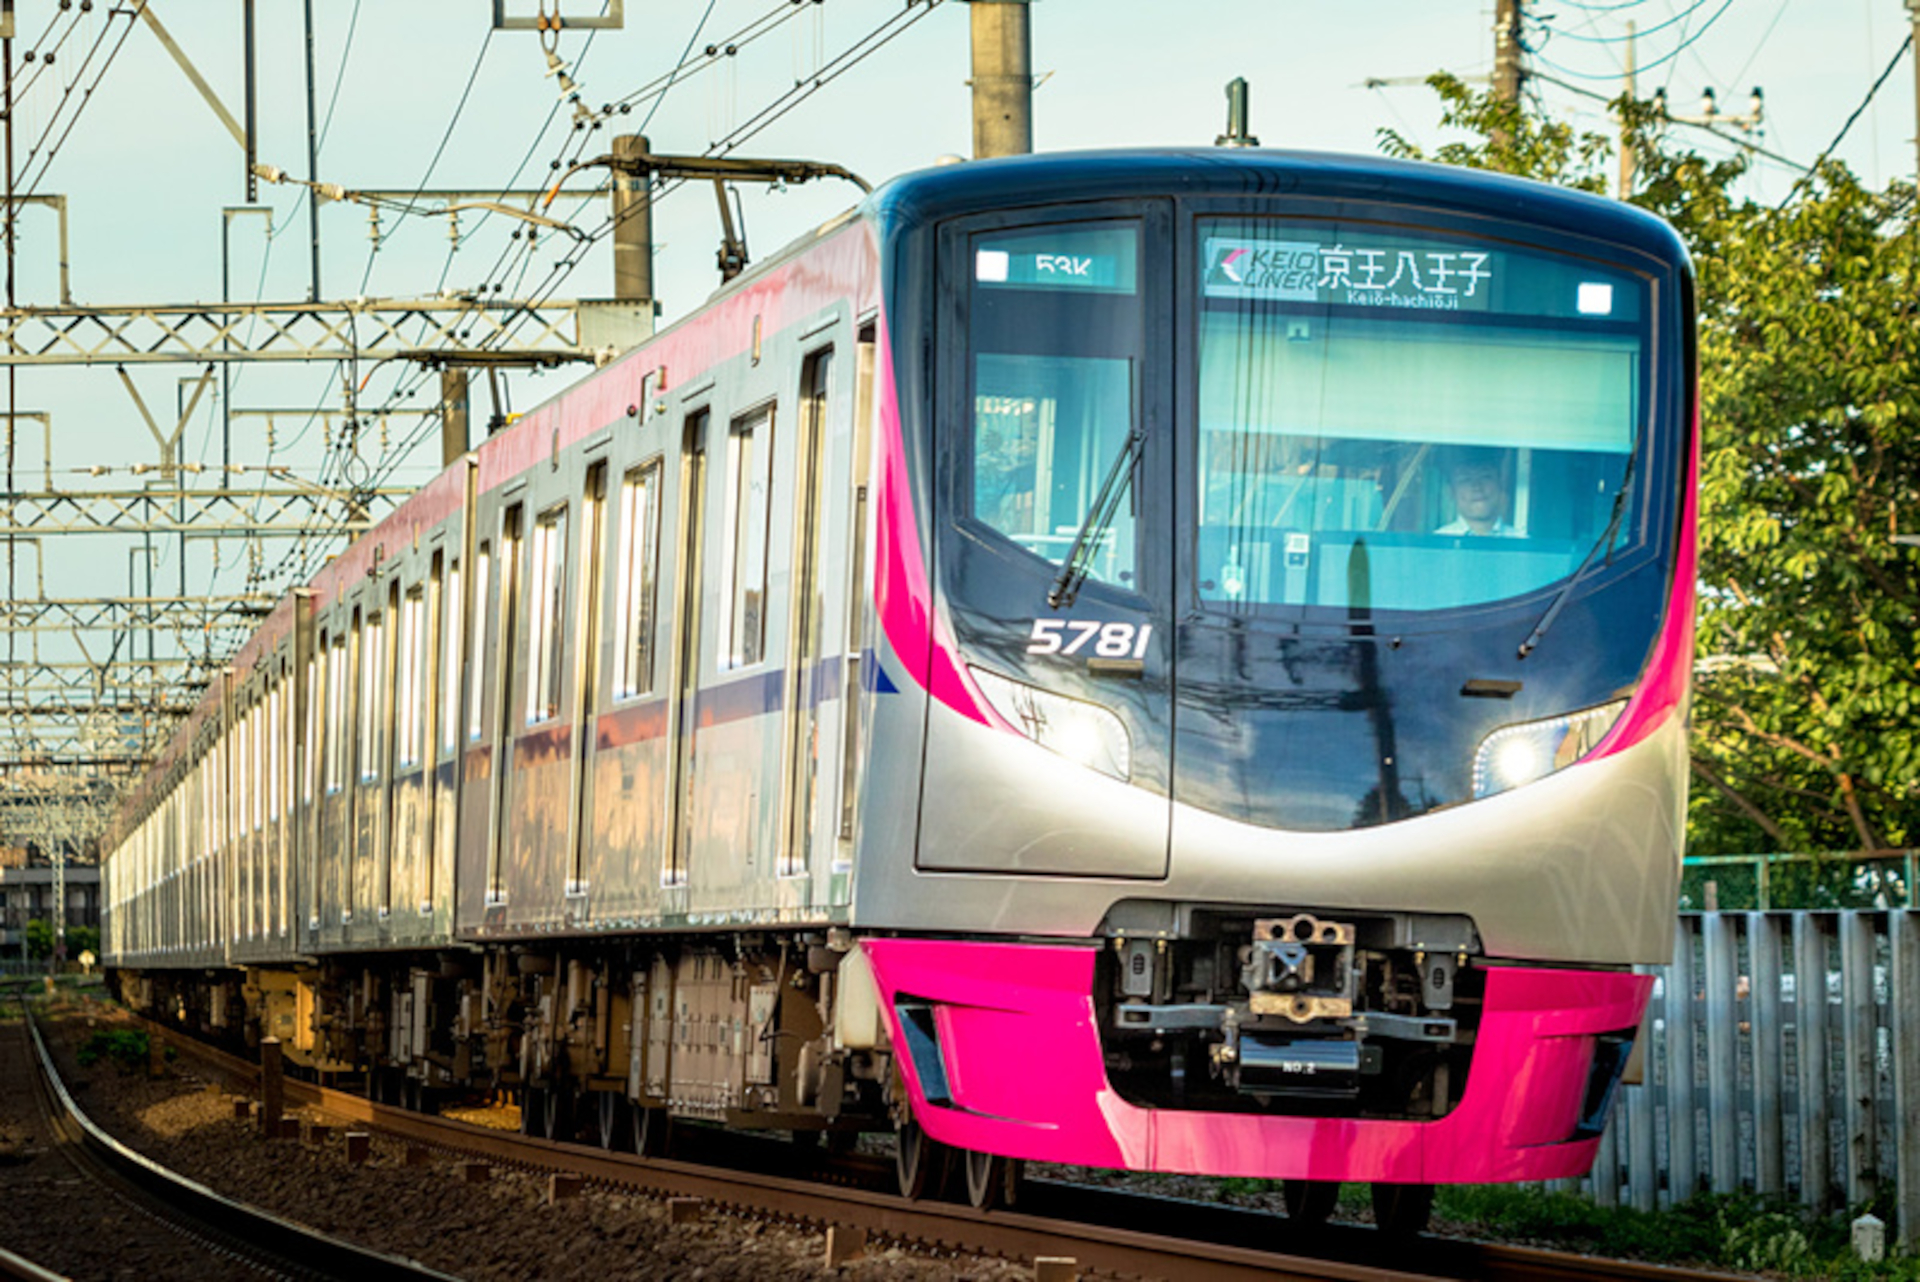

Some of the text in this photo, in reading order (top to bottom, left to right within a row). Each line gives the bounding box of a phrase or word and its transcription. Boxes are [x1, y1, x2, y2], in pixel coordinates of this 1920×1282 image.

[1250, 249, 1316, 270] KEIO
[1317, 244, 1491, 296] 京王八王子
[1243, 270, 1316, 291] LINER
[1026, 618, 1153, 659] 5781
